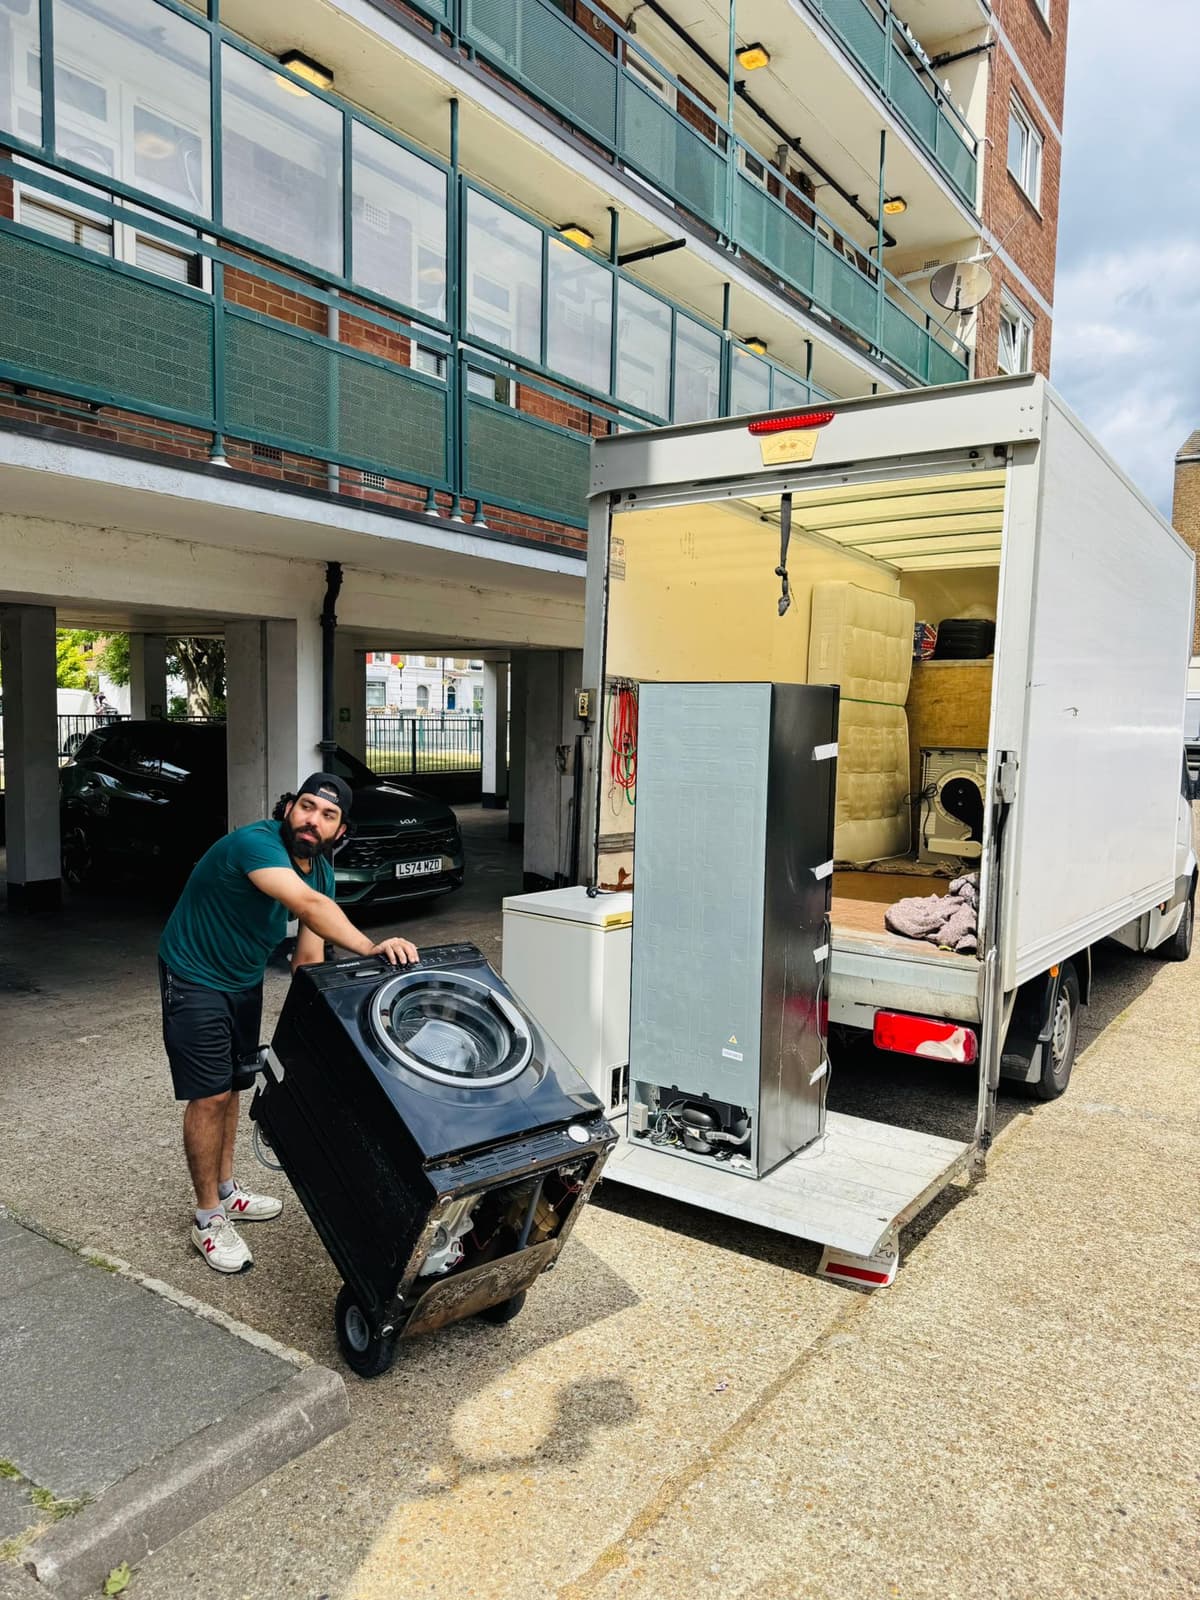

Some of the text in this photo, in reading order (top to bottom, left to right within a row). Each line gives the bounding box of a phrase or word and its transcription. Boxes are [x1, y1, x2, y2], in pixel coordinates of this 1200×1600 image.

[399, 861, 422, 875] LS74
[230, 1198, 250, 1212] N
[203, 1237, 216, 1254] N
